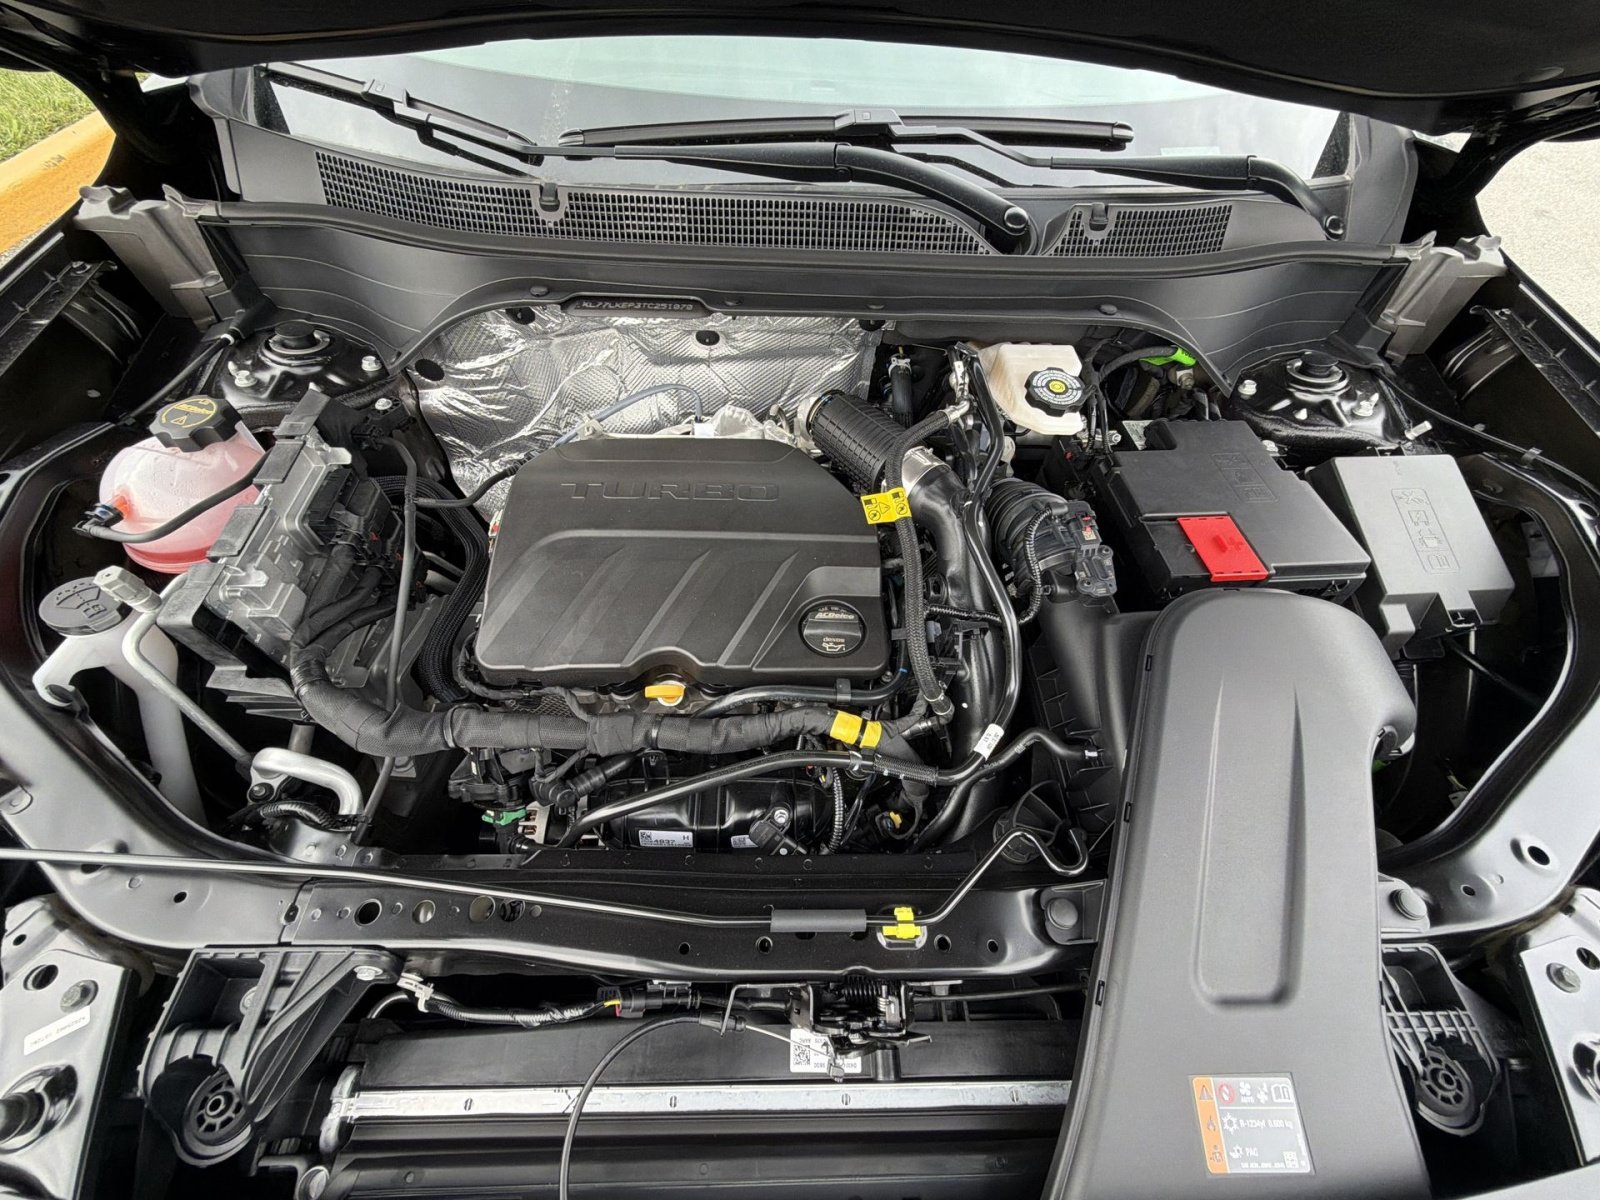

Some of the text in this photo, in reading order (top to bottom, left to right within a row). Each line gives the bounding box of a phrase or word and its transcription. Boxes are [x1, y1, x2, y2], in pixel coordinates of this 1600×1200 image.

[561, 482, 779, 502] TURBO
[814, 612, 855, 620] ACDelco
[1245, 1147, 1259, 1157] PAG
